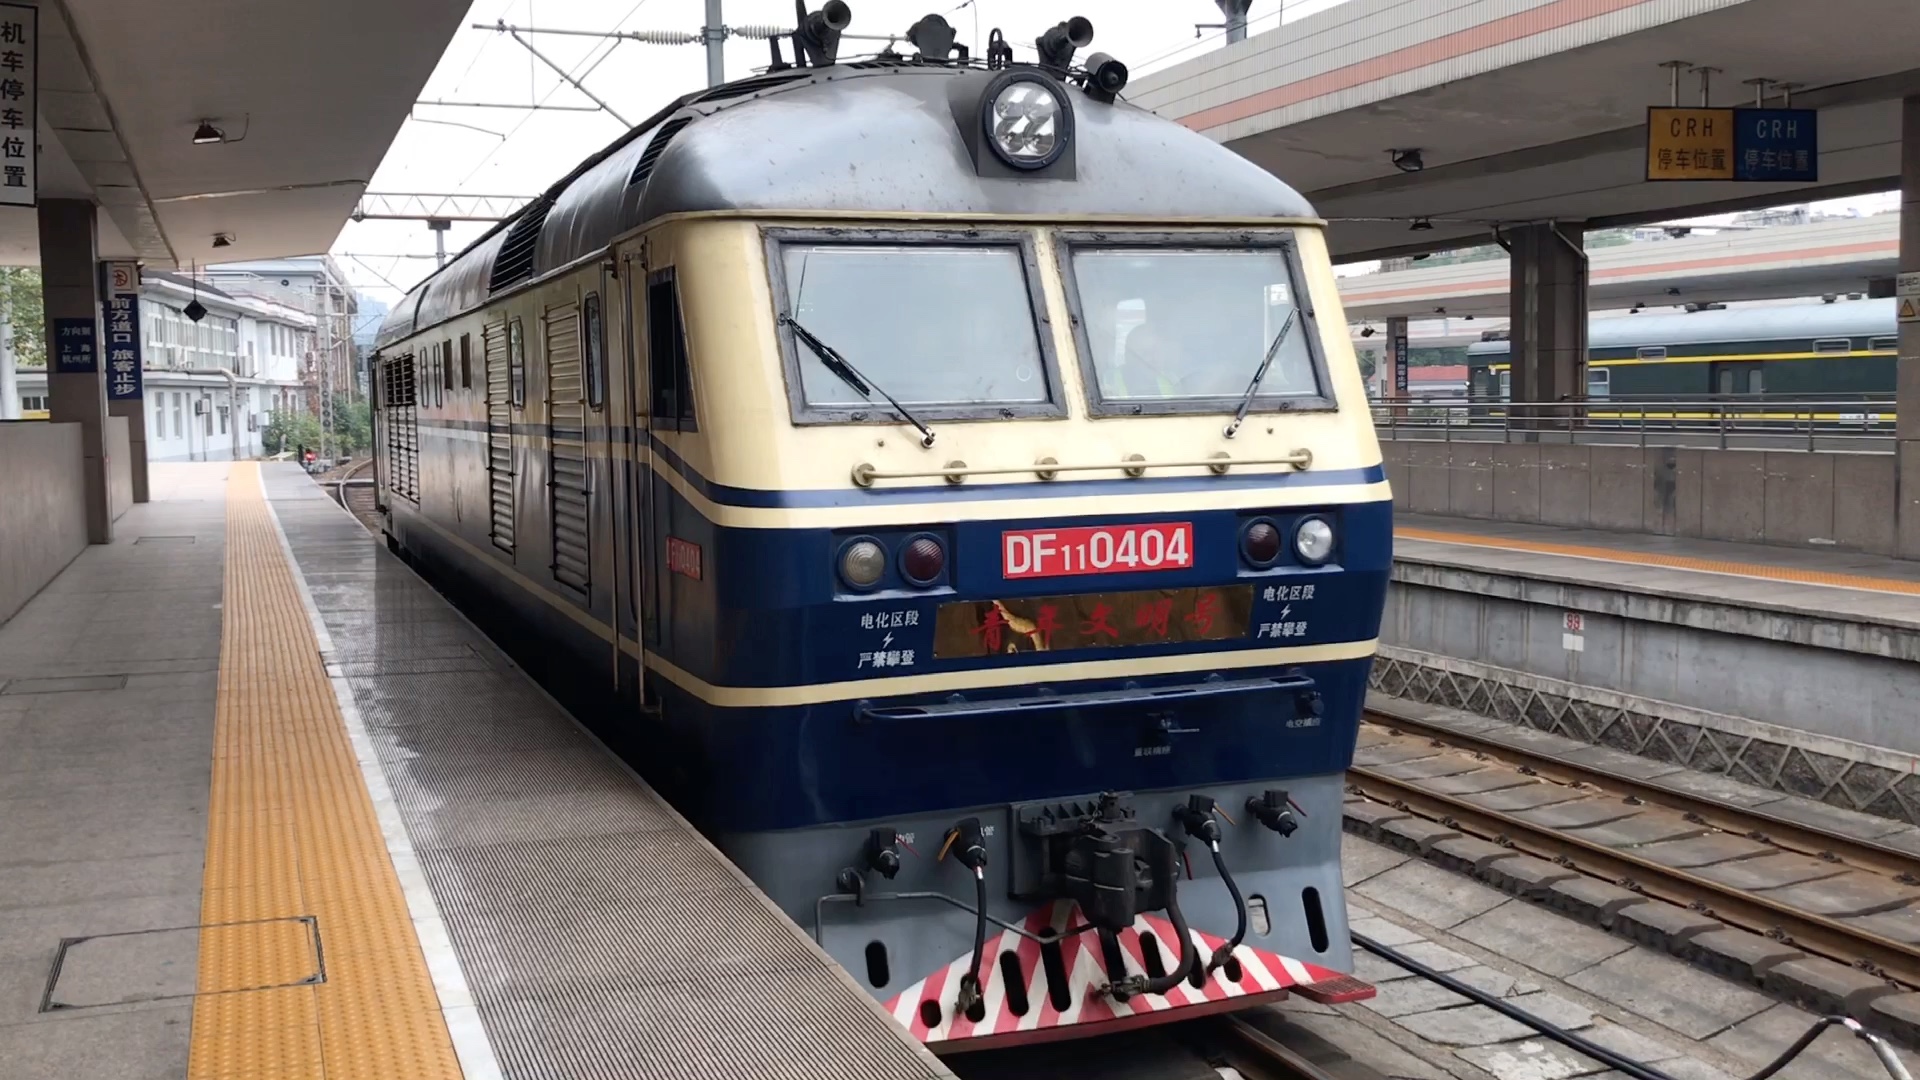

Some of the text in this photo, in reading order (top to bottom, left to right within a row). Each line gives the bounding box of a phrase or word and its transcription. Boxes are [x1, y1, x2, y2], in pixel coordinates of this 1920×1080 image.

[0, 21, 27, 187] 机车停车位置
[1670, 118, 1713, 137] CRH
[1757, 120, 1797, 138] CRH
[1658, 148, 1726, 171] 停车位置
[1744, 150, 1808, 171] 停车位置
[110, 298, 136, 395] 前方道口 旅客止步
[1006, 528, 1189, 574] DF110404
[1263, 585, 1315, 601] 电化区段
[861, 610, 919, 629] 电化区段
[970, 594, 1221, 650] 青年文明号
[1257, 621, 1307, 639] 严禁攀登
[857, 649, 915, 669] 严禁攀登
